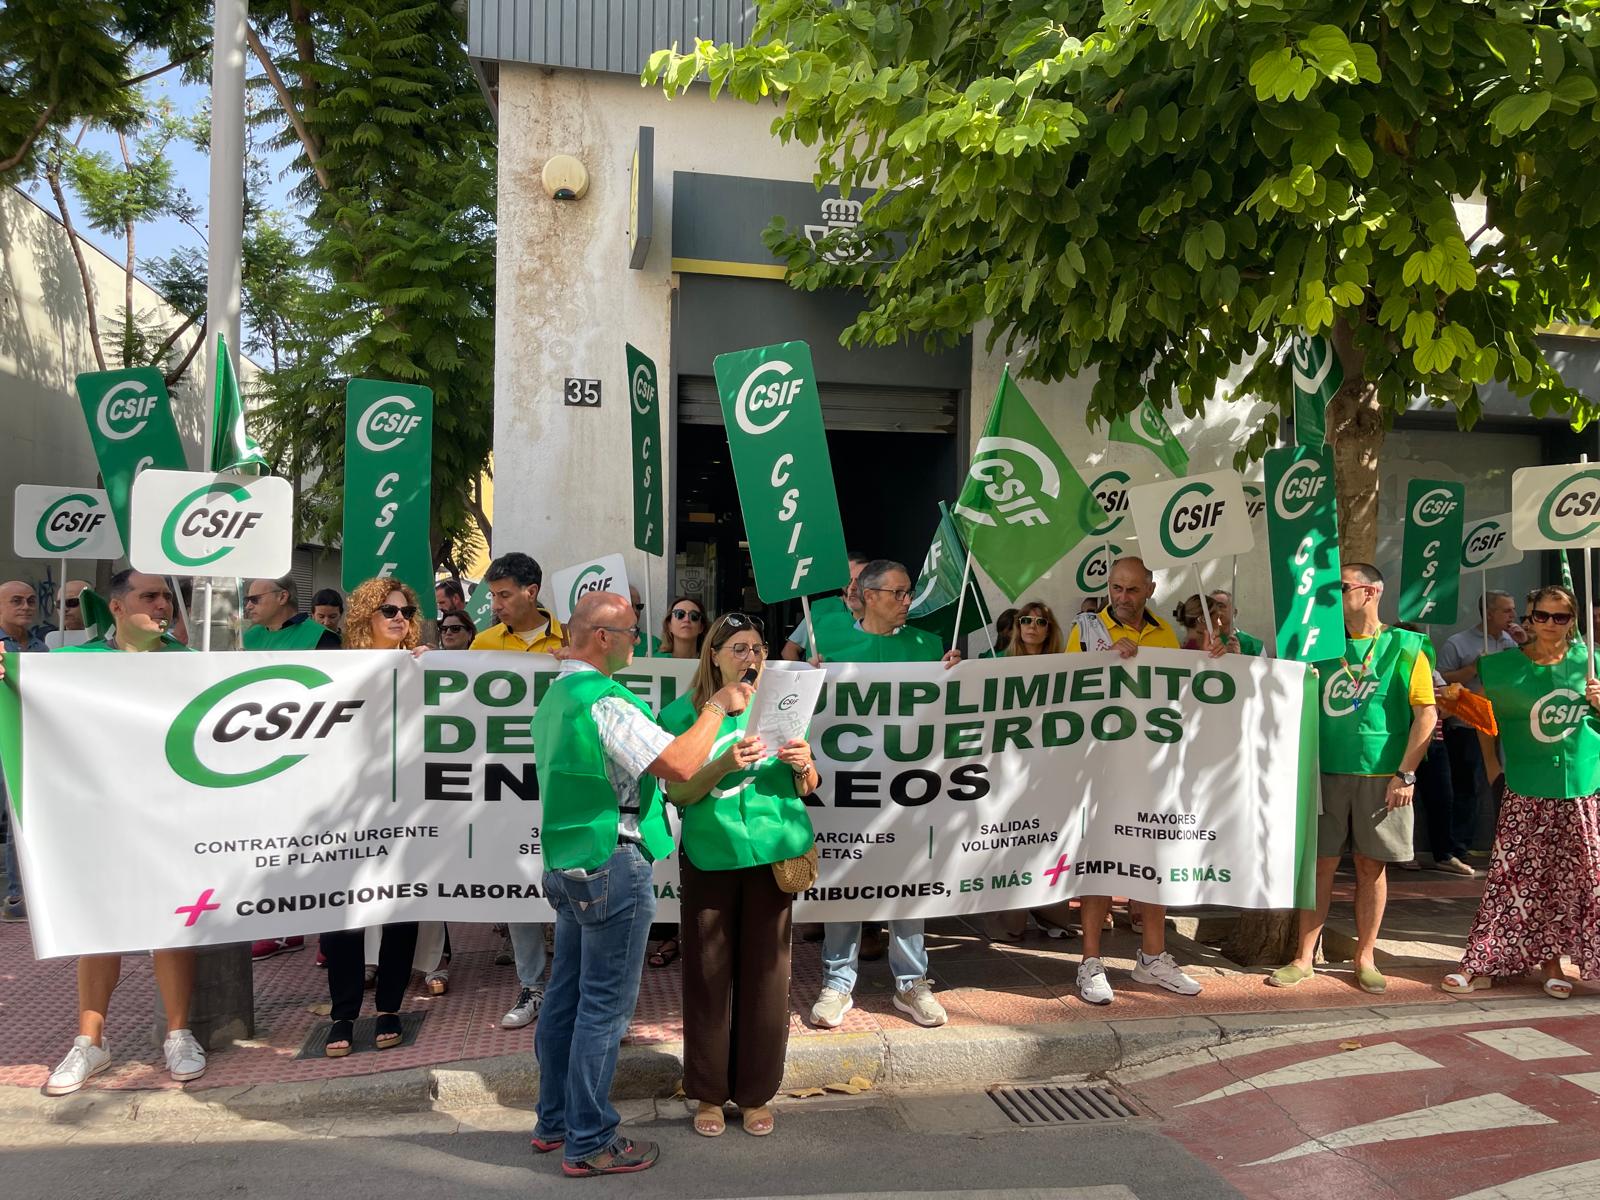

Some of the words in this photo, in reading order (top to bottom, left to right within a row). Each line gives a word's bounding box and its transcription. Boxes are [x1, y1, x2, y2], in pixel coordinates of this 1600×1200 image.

[567, 379, 600, 404] 35
[636, 377, 655, 403] CSIF
[749, 378, 804, 411] CSIF
[109, 396, 158, 421] CSIF
[370, 411, 423, 434] CSIF
[642, 436, 654, 545] CSIF
[969, 458, 1050, 528] CSIF
[1285, 475, 1327, 501] CSIF
[1173, 500, 1226, 534] CSIF
[1421, 500, 1458, 515] CSIF
[1555, 491, 1600, 519] CSI
[50, 511, 107, 533] CSIF
[181, 507, 264, 539] CSIF
[771, 453, 813, 590] CSIF
[1470, 531, 1507, 552] CSIF
[1418, 540, 1441, 619] CSIF
[1294, 536, 1320, 656] CSIF
[1331, 677, 1381, 700] CSIF
[211, 699, 366, 744] CSIF
[1541, 703, 1590, 725] CSIF
[424, 715, 535, 754] DE
[810, 705, 1184, 763] CUERDOS
[424, 762, 540, 801] EN
[980, 818, 1040, 835] SALIDAS
[1137, 812, 1196, 826] MAYORES
[194, 830, 347, 855] CONTRATACIÓN
[354, 825, 439, 844] URGENTE
[813, 831, 895, 844] ARCIALES
[961, 831, 1058, 852] VOLUNTARIAS
[1114, 825, 1217, 841] RETRIBUCIONES
[255, 855, 281, 868] DE
[287, 845, 389, 866] PLANTILLA
[959, 877, 985, 893] ES
[991, 869, 1033, 890] MÁS
[1075, 860, 1162, 886] EMPLEO,
[1169, 868, 1189, 882] ES
[1191, 864, 1232, 883] MÁS
[236, 881, 428, 917] CONDICIONES
